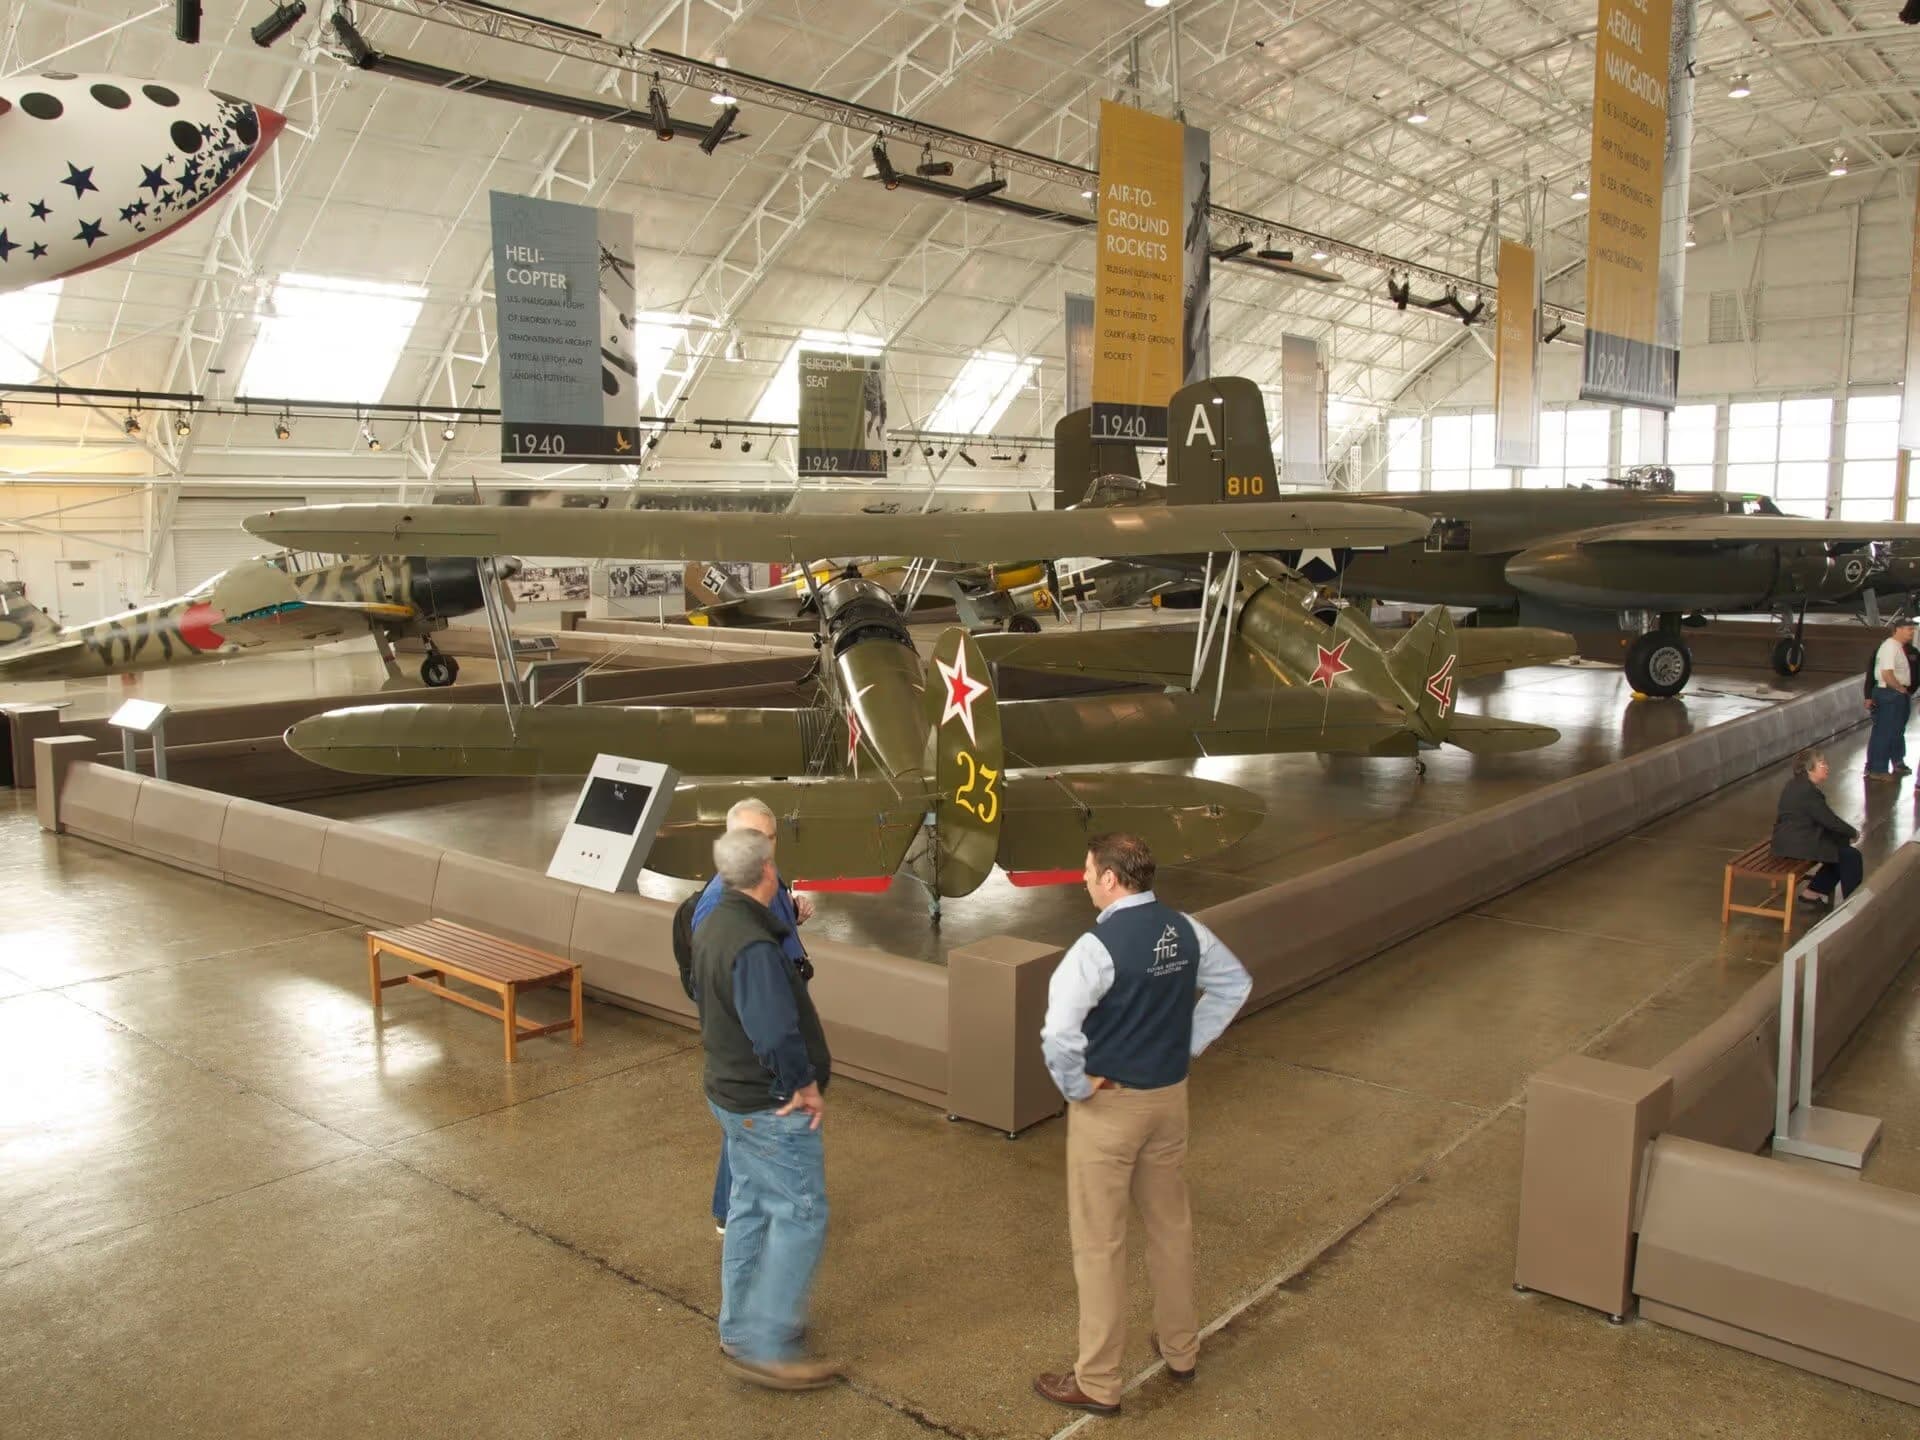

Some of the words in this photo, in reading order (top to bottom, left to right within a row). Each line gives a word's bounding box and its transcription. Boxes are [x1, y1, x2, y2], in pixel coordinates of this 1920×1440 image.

[1606, 8, 1643, 54] AERIAL
[1605, 50, 1666, 110] NAVIGATION
[1108, 183, 1157, 207] AIR-TO-
[1108, 208, 1169, 236] GROUND
[505, 244, 545, 263] HELI-
[1106, 234, 1168, 262] ROCKETS
[506, 267, 567, 290] COPTER
[806, 375, 829, 388] SEAT
[1100, 415, 1146, 438] 1940
[1185, 403, 1217, 447] A
[512, 433, 565, 456] 1940
[806, 455, 838, 471] 1942
[1228, 476, 1263, 496] 810
[1426, 654, 1457, 719] 4
[956, 751, 999, 823] 23
